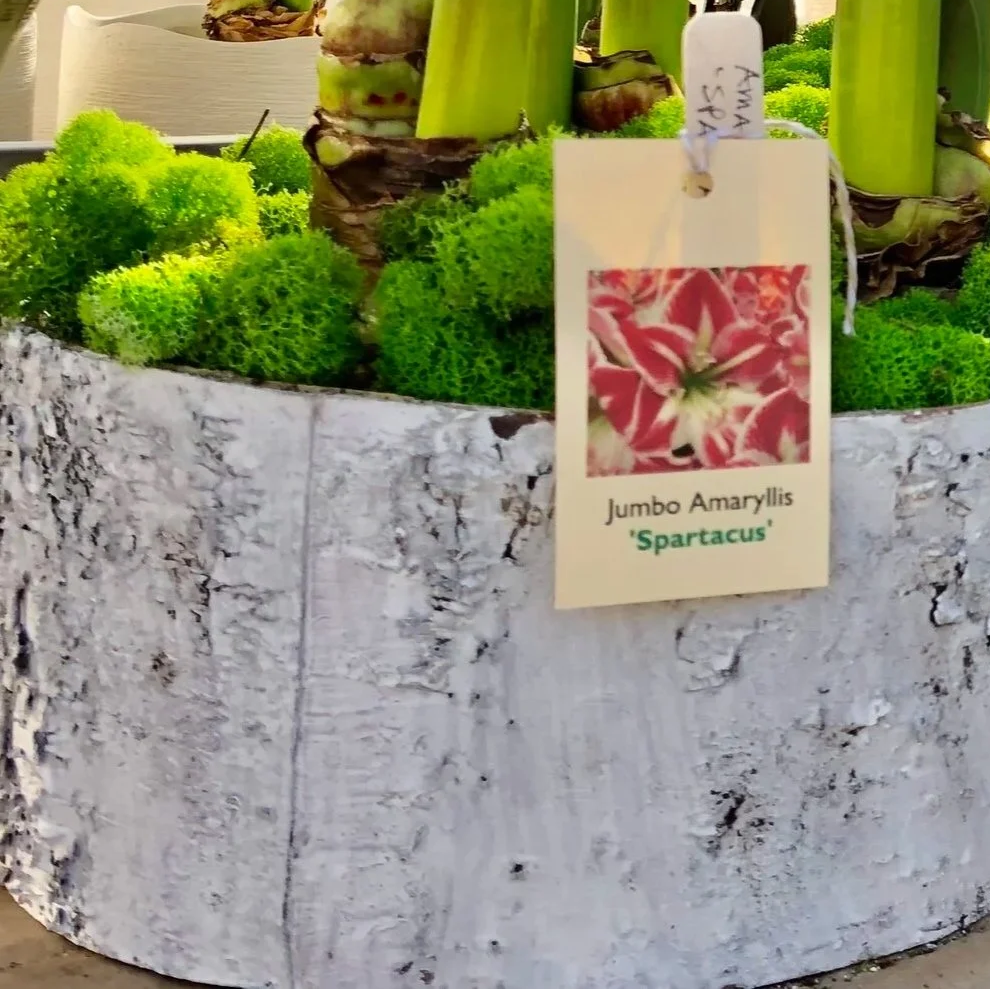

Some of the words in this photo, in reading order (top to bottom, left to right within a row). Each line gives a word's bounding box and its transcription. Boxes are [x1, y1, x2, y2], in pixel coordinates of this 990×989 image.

[605, 495, 681, 526] Jumbo
[689, 486, 794, 515] Amaryllis
[629, 519, 773, 555] 'Spartacus'
